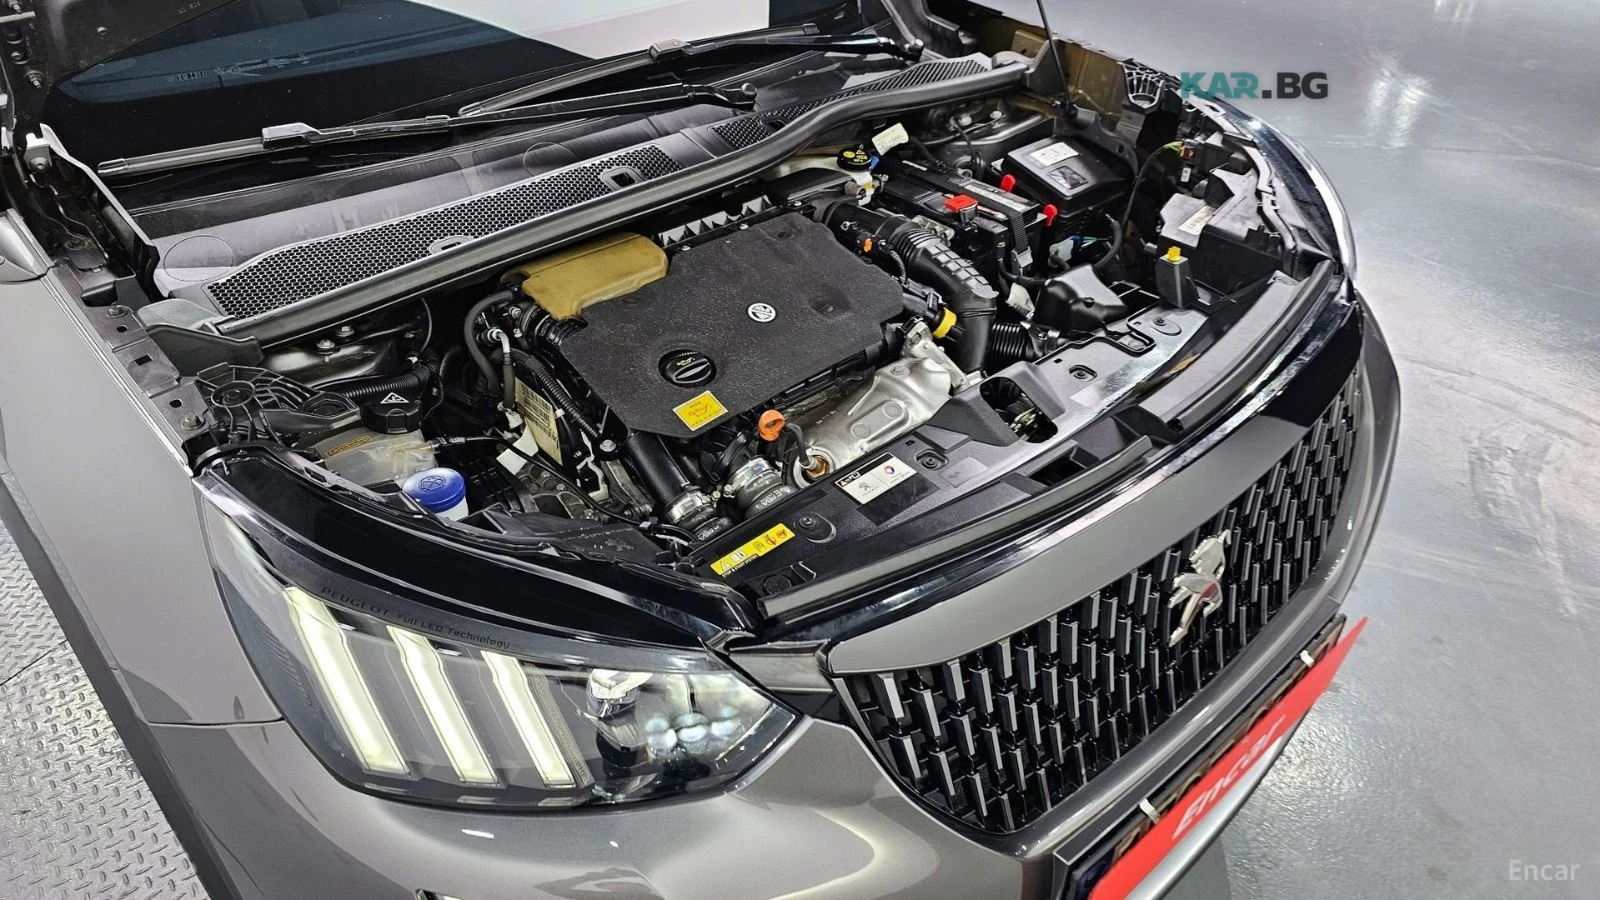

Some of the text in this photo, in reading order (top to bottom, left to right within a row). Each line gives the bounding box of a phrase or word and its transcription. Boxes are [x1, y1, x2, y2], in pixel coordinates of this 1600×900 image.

[321, 586, 511, 650] PEUGEOT Full LED Technology
[1171, 714, 1287, 840] Encar
